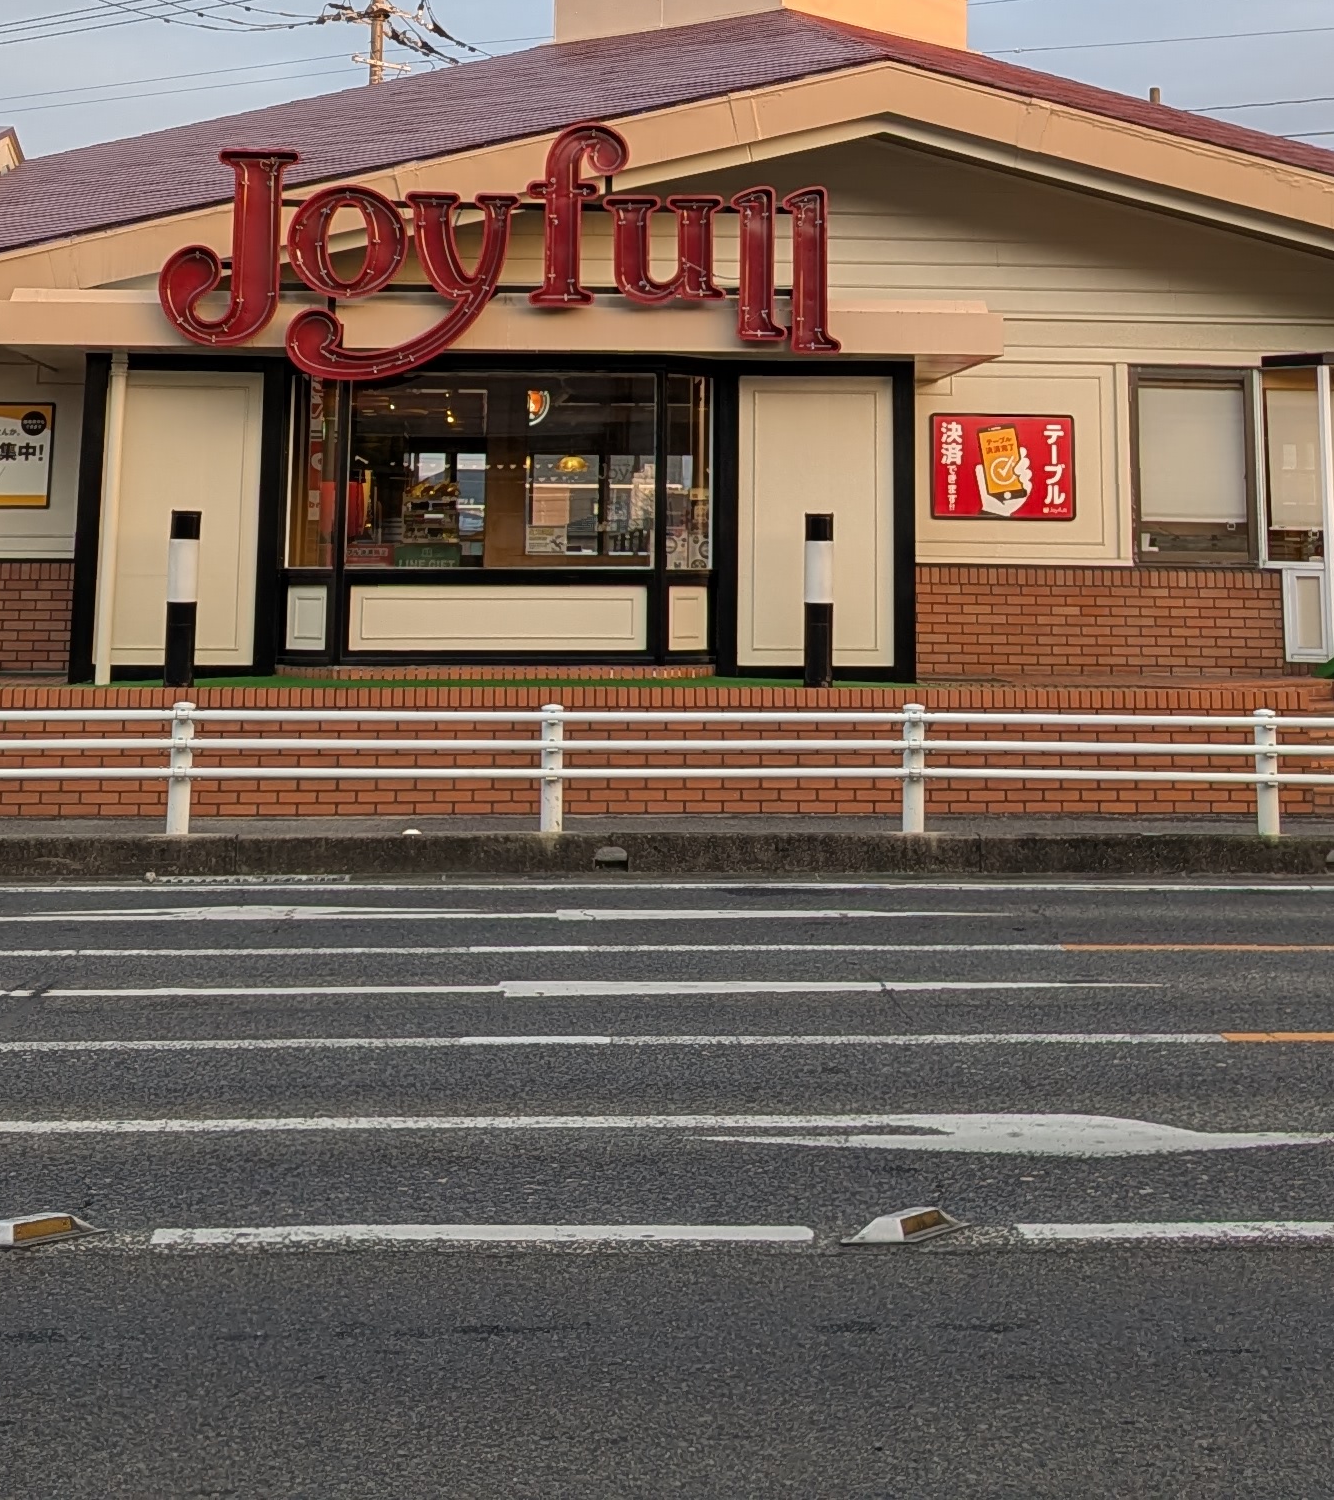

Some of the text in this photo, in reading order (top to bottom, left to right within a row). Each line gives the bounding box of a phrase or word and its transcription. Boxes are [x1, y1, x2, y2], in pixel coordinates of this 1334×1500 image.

[158, 121, 841, 380] Joyfull
[1043, 424, 1066, 505] テーブル
